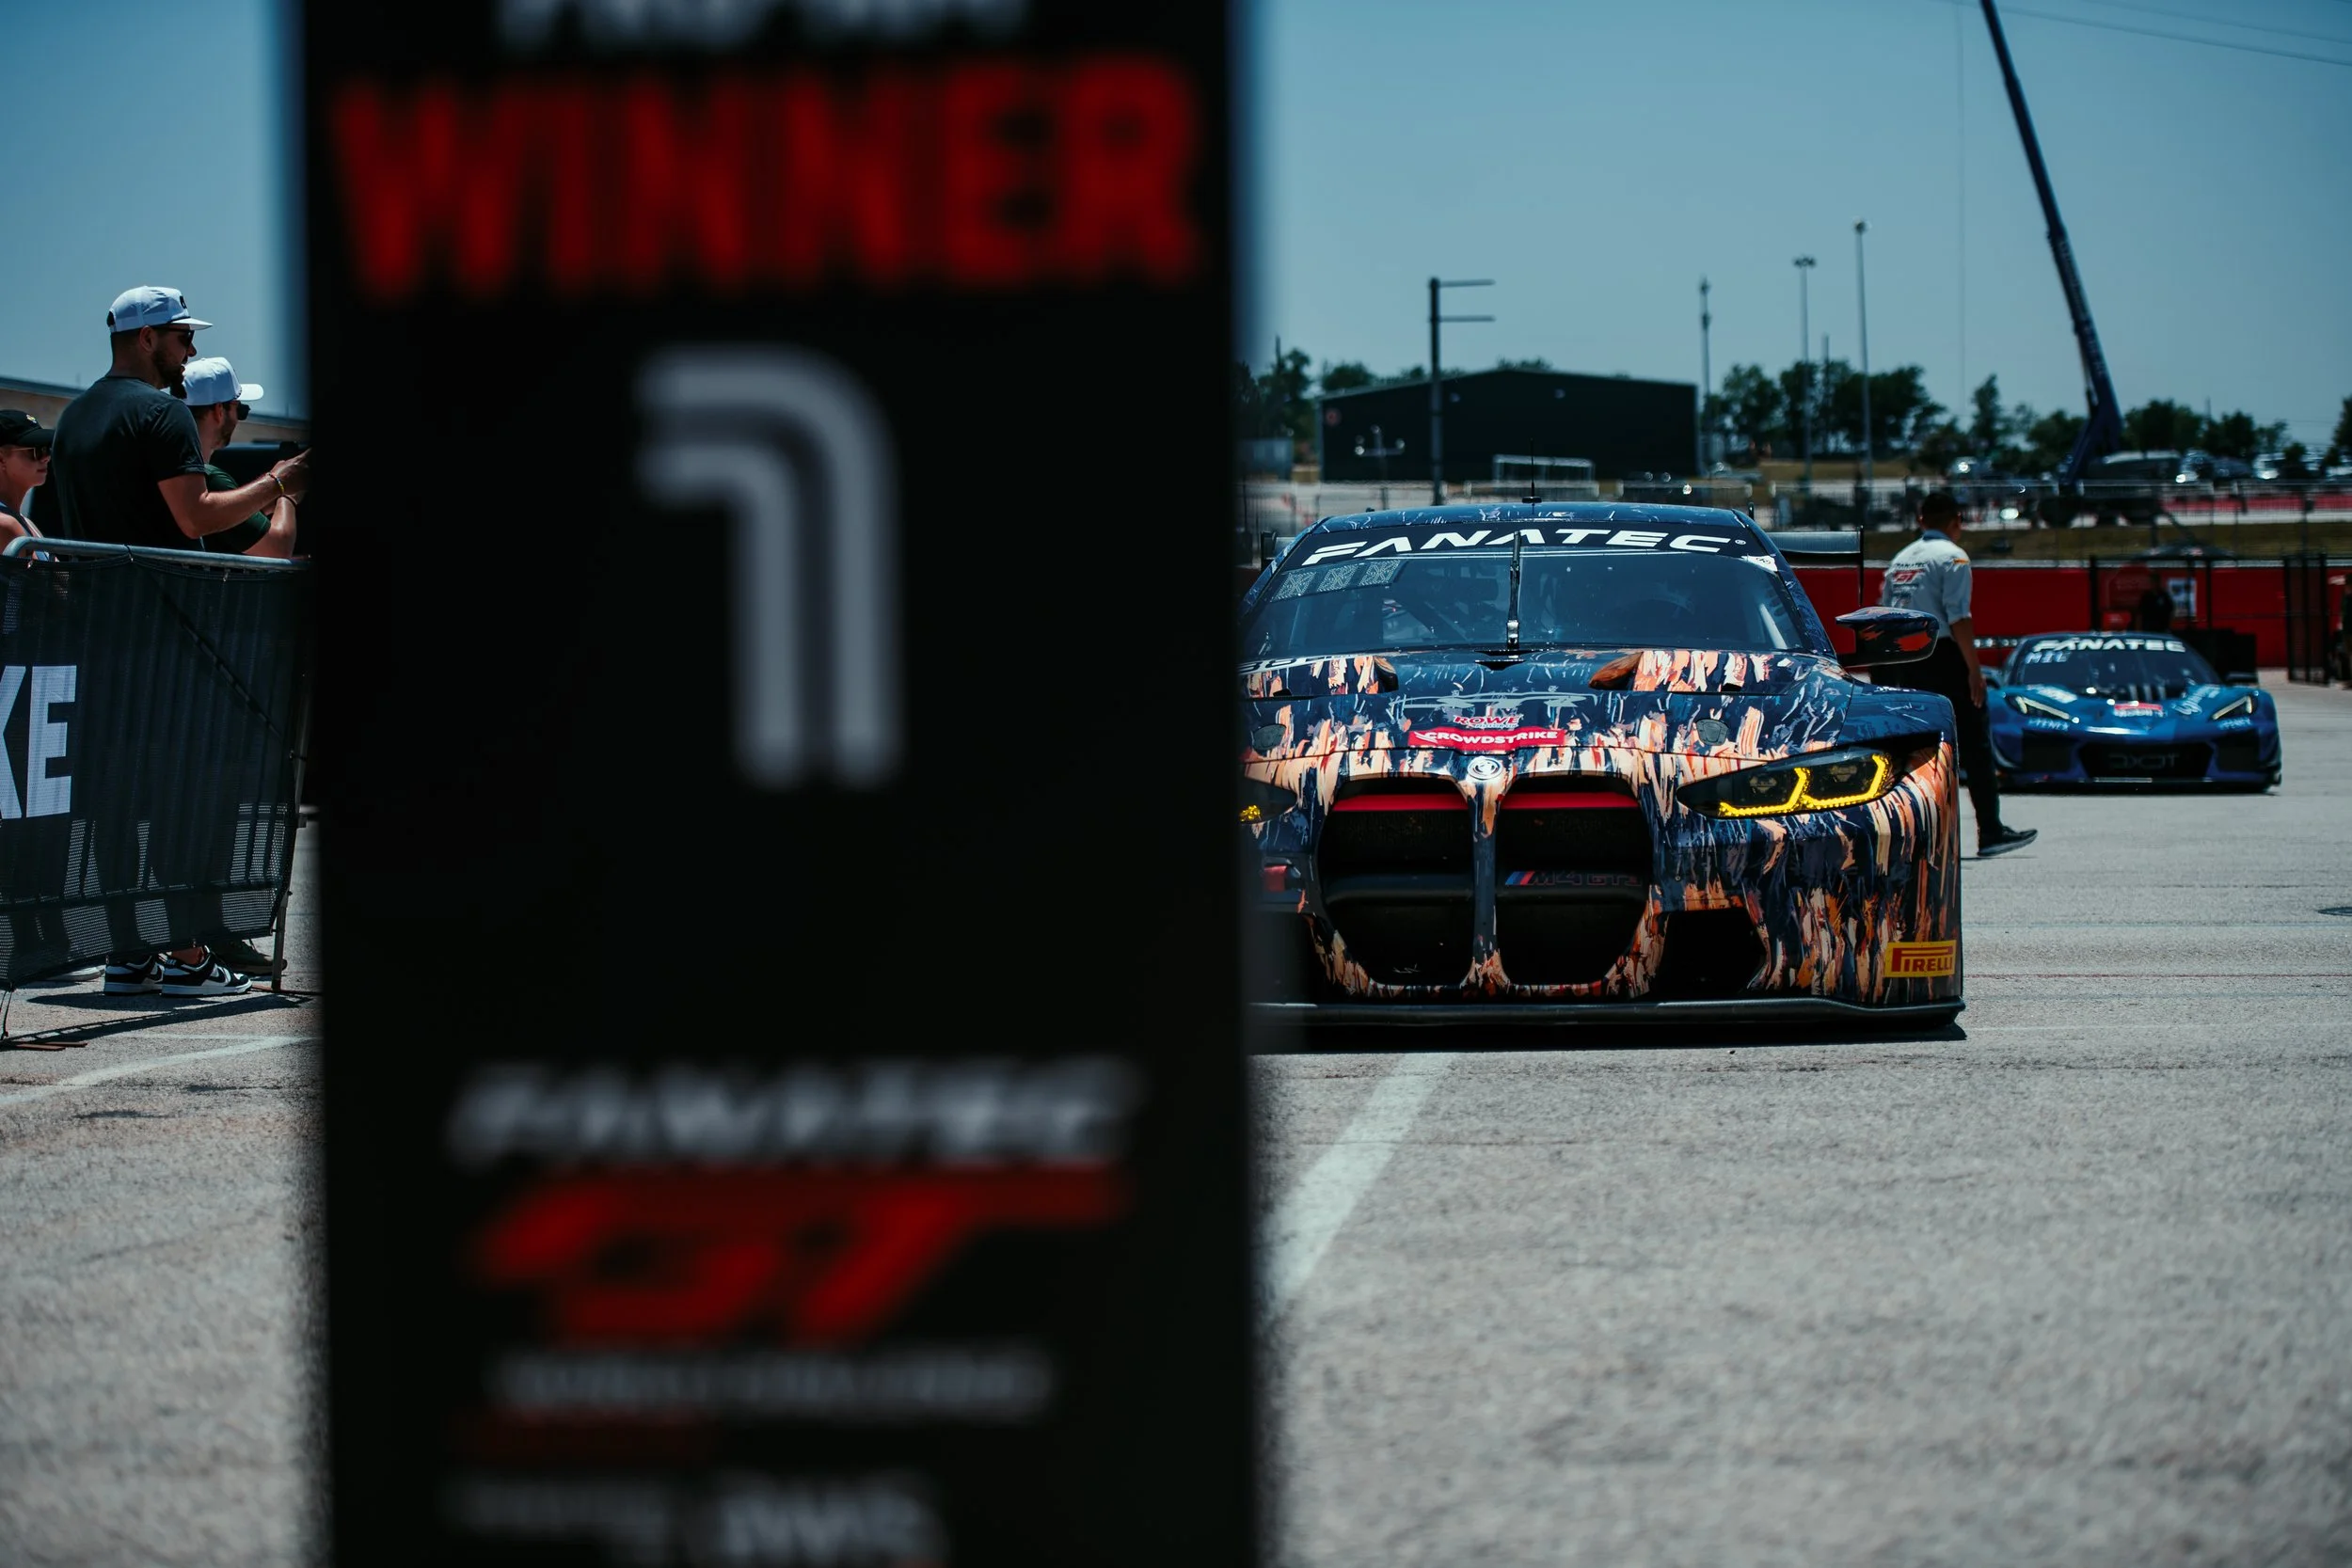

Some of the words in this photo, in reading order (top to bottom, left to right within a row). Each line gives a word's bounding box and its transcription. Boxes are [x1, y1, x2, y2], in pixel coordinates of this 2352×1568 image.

[337, 58, 1195, 290] WINNER
[644, 351, 899, 783] 1
[2032, 639, 2186, 653] FANATEC
[1454, 716, 1521, 725] ROWE
[1423, 732, 1558, 744] CROWDSTRIKE
[1891, 946, 1953, 973] PIRELLI
